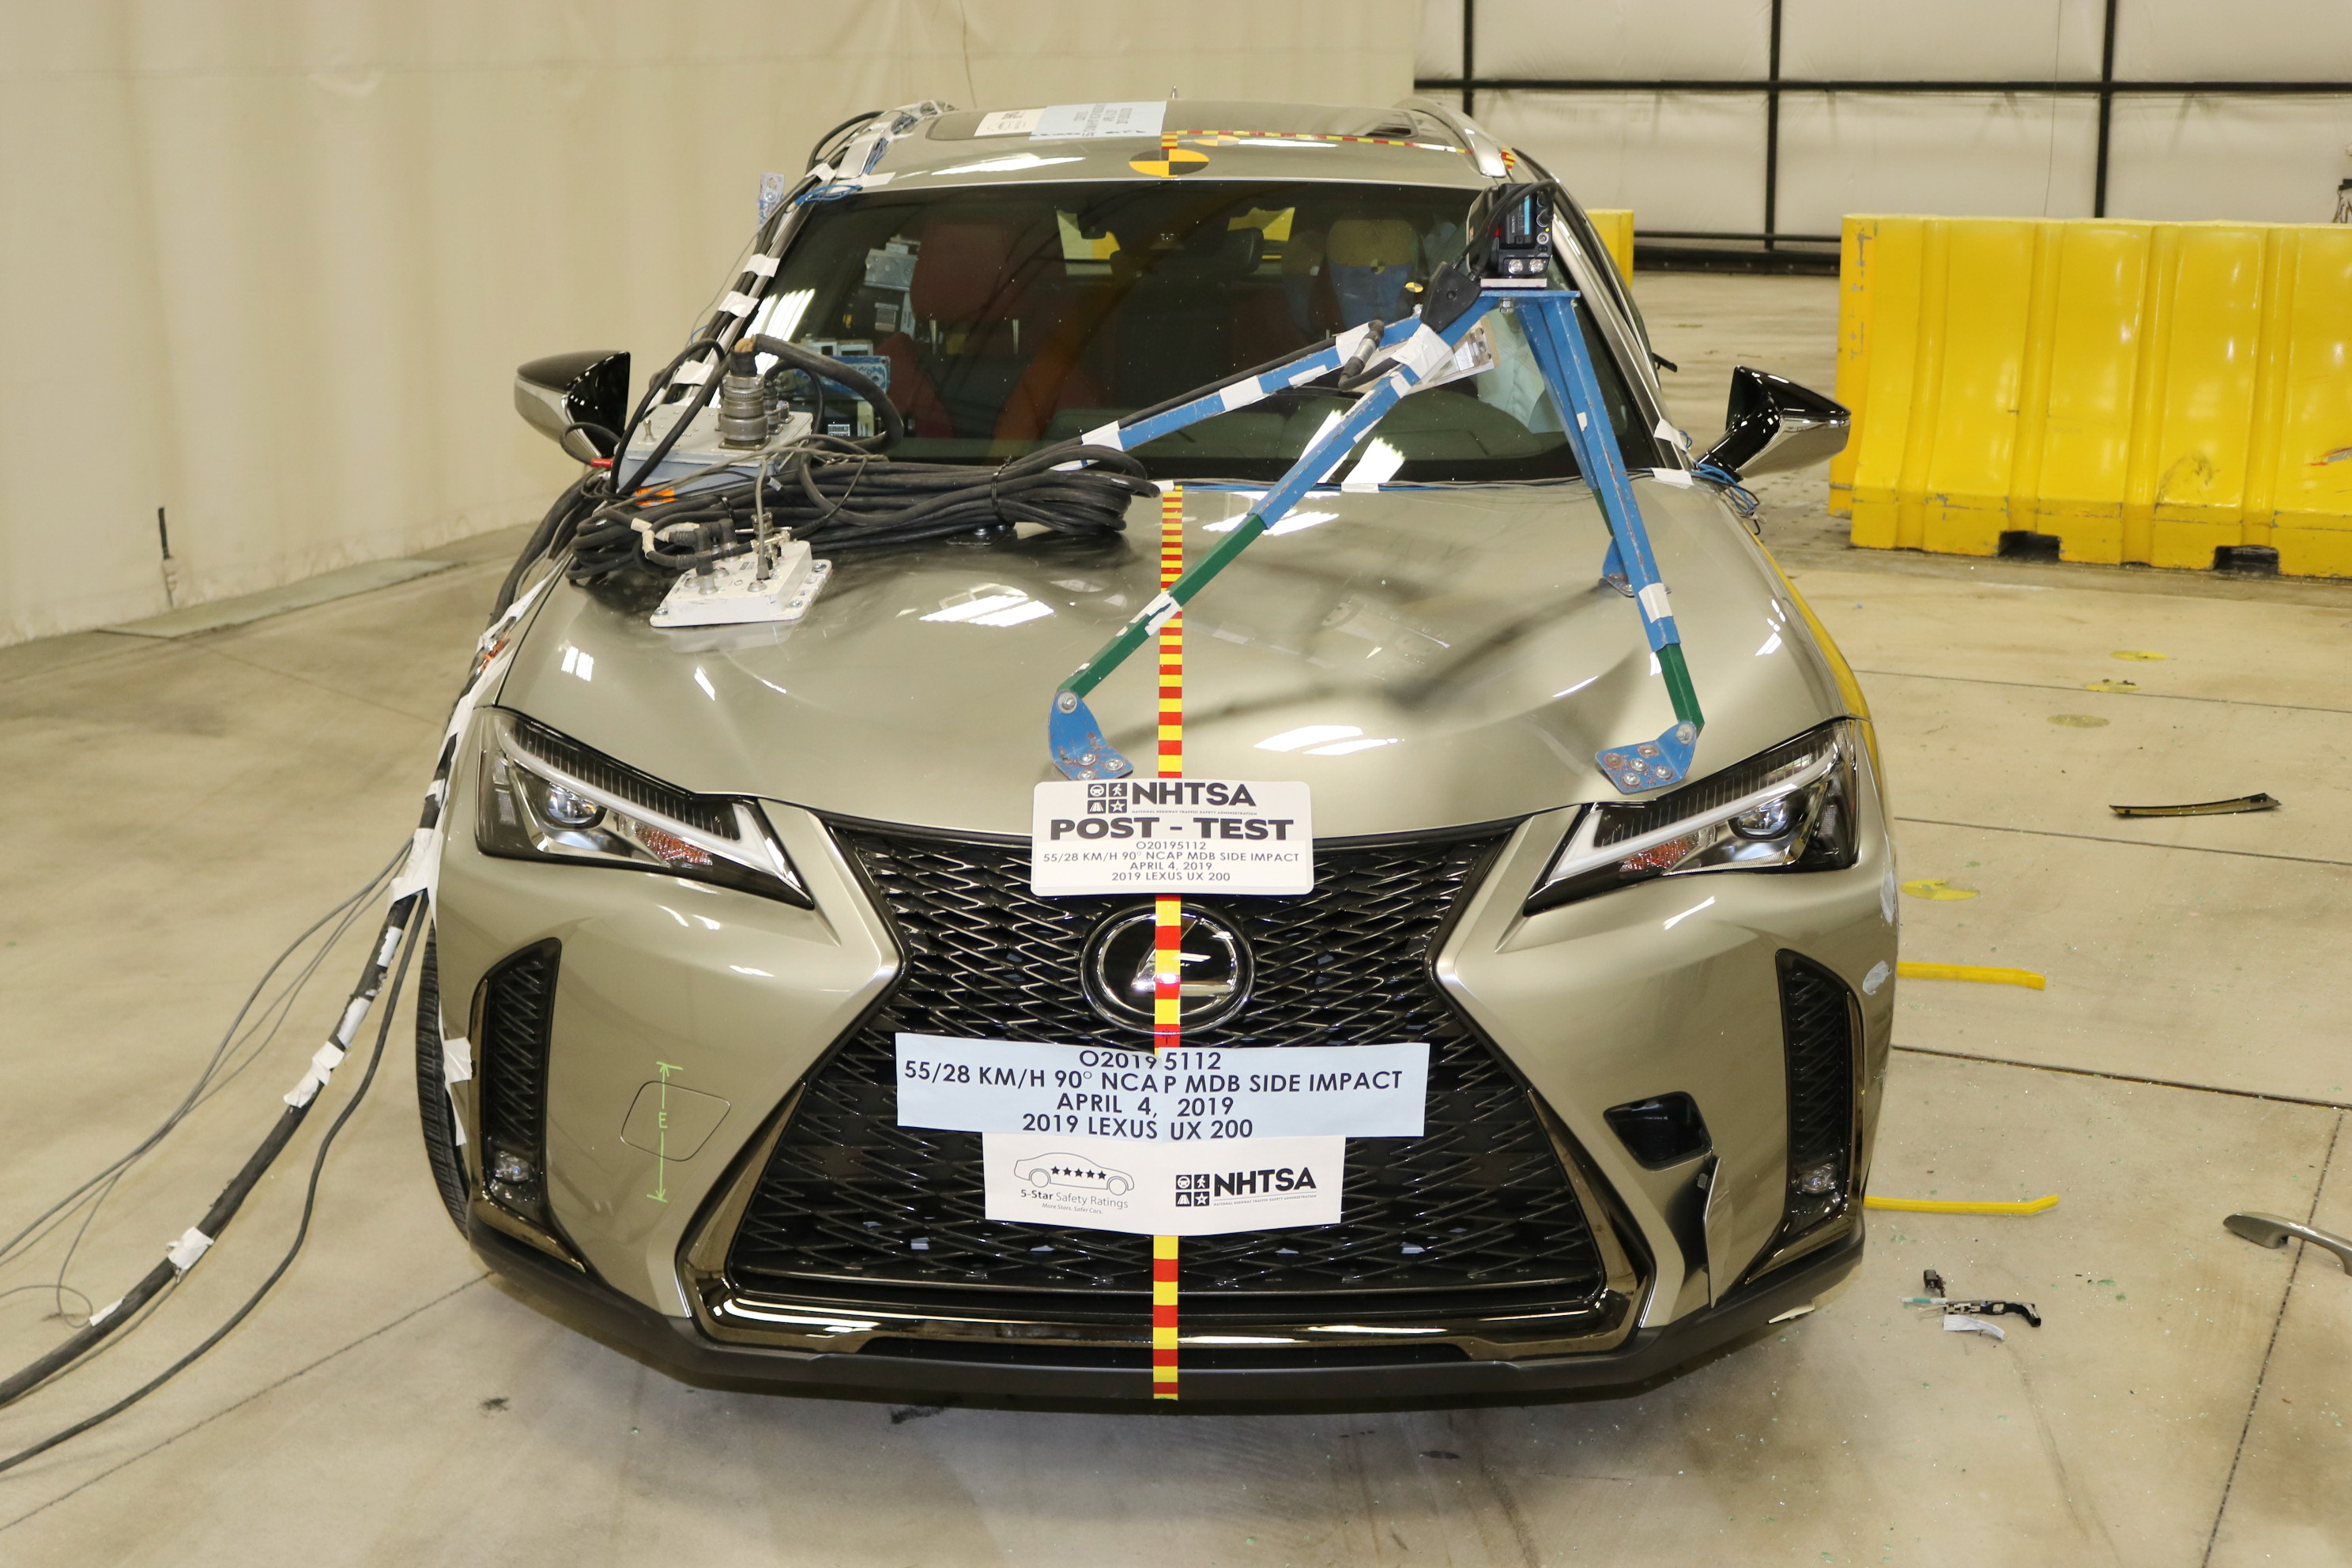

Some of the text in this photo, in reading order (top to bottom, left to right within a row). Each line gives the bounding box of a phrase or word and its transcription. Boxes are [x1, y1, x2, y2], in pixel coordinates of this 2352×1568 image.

[1132, 782, 1257, 807] NHTSA
[1050, 816, 1159, 840] POST
[1193, 817, 1294, 840] TEST
[1042, 851, 1299, 863] 55/28 KM/H 90° NCAP MDB SIDE IMPACT
[1129, 861, 1212, 871] APRIL 4, 2019
[1111, 872, 1231, 881] 2019 LEXUS UX 200
[904, 1060, 1403, 1094] 55/28 KM/H 90° NCAP MDB SIDE IMPACT
[1056, 1092, 1234, 1118] APRIL 4, 2019
[658, 1111, 668, 1129] E
[1022, 1113, 1253, 1140] 2019 LEXUS UX 200
[1214, 1167, 1317, 1197] NHTSA
[1020, 1189, 1129, 1210] 5-Star Safety Ratings
